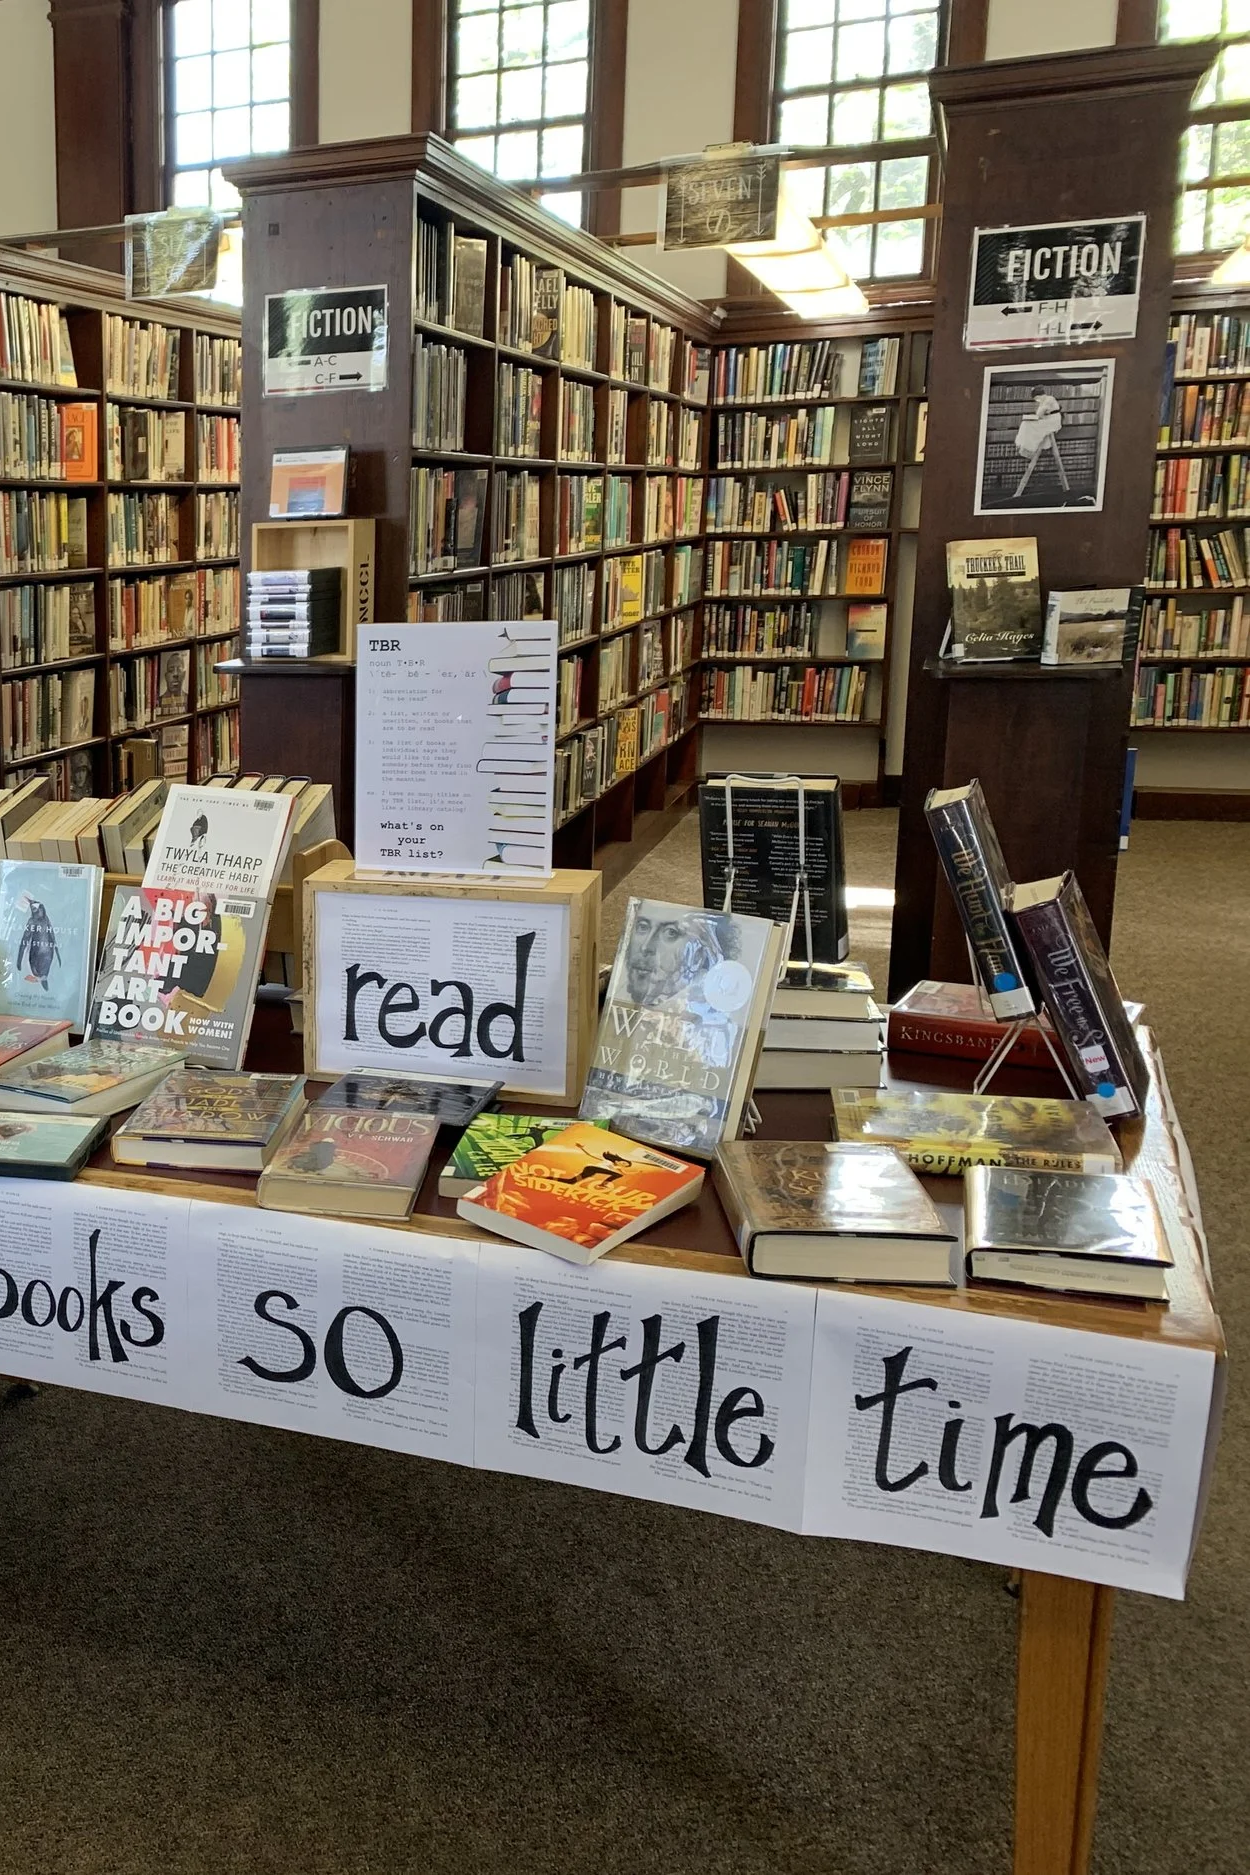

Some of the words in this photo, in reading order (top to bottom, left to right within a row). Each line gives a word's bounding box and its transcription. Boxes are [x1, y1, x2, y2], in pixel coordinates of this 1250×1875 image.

[688, 174, 754, 206] SEVEN
[1007, 241, 1122, 282] FICTION
[1038, 302, 1068, 314] F-H
[288, 305, 373, 339] FICTION
[1038, 322, 1065, 335] H-L
[313, 355, 337, 367] A-C
[315, 373, 336, 384] C-F
[854, 475, 891, 485] VINCE
[853, 484, 890, 493] FLYNN
[854, 520, 883, 528] HONOR
[1005, 555, 1026, 571] TRAIL
[369, 640, 401, 651] TBR
[965, 632, 993, 644] Celia
[996, 631, 1035, 644] Hayes
[380, 821, 422, 831] what's
[398, 837, 426, 846] your
[165, 846, 208, 864] TWYLA
[216, 852, 263, 871] THARP
[380, 848, 402, 857] TBR
[408, 850, 444, 859] list?
[161, 862, 178, 874] THE
[181, 864, 225, 879] CREATIVE
[229, 871, 259, 884] HABIT
[157, 875, 175, 884] LEARN
[187, 878, 200, 886] AND
[225, 883, 238, 891] FOR
[240, 886, 255, 894] LIFE
[121, 896, 142, 919] A
[155, 898, 207, 925] BIG
[46, 925, 78, 935] HOUSE
[115, 921, 229, 954] IMPOR-
[112, 948, 188, 978] TANT
[1047, 946, 1076, 977] We
[103, 975, 164, 1004] ART
[343, 931, 536, 1062] read
[1049, 977, 1085, 1016] Free
[98, 1001, 190, 1035] BOOK
[189, 1017, 210, 1026] NOW
[213, 1020, 235, 1030] WITH
[187, 1025, 233, 1040] WOMEN!
[900, 1026, 1002, 1051] KINGSBANE
[599, 1045, 720, 1091] WORLD
[1085, 1055, 1106, 1065] New
[188, 1086, 256, 1096] GODS
[141, 1108, 268, 1122] SHADOW
[303, 1113, 433, 1136] VICIOUS
[908, 1153, 1002, 1168] HOFFMAN
[1015, 1157, 1037, 1167] THE
[1043, 1158, 1083, 1169] RULES
[510, 1162, 567, 1179] NOT
[516, 1301, 774, 1478] little
[855, 1346, 1152, 1538] time
